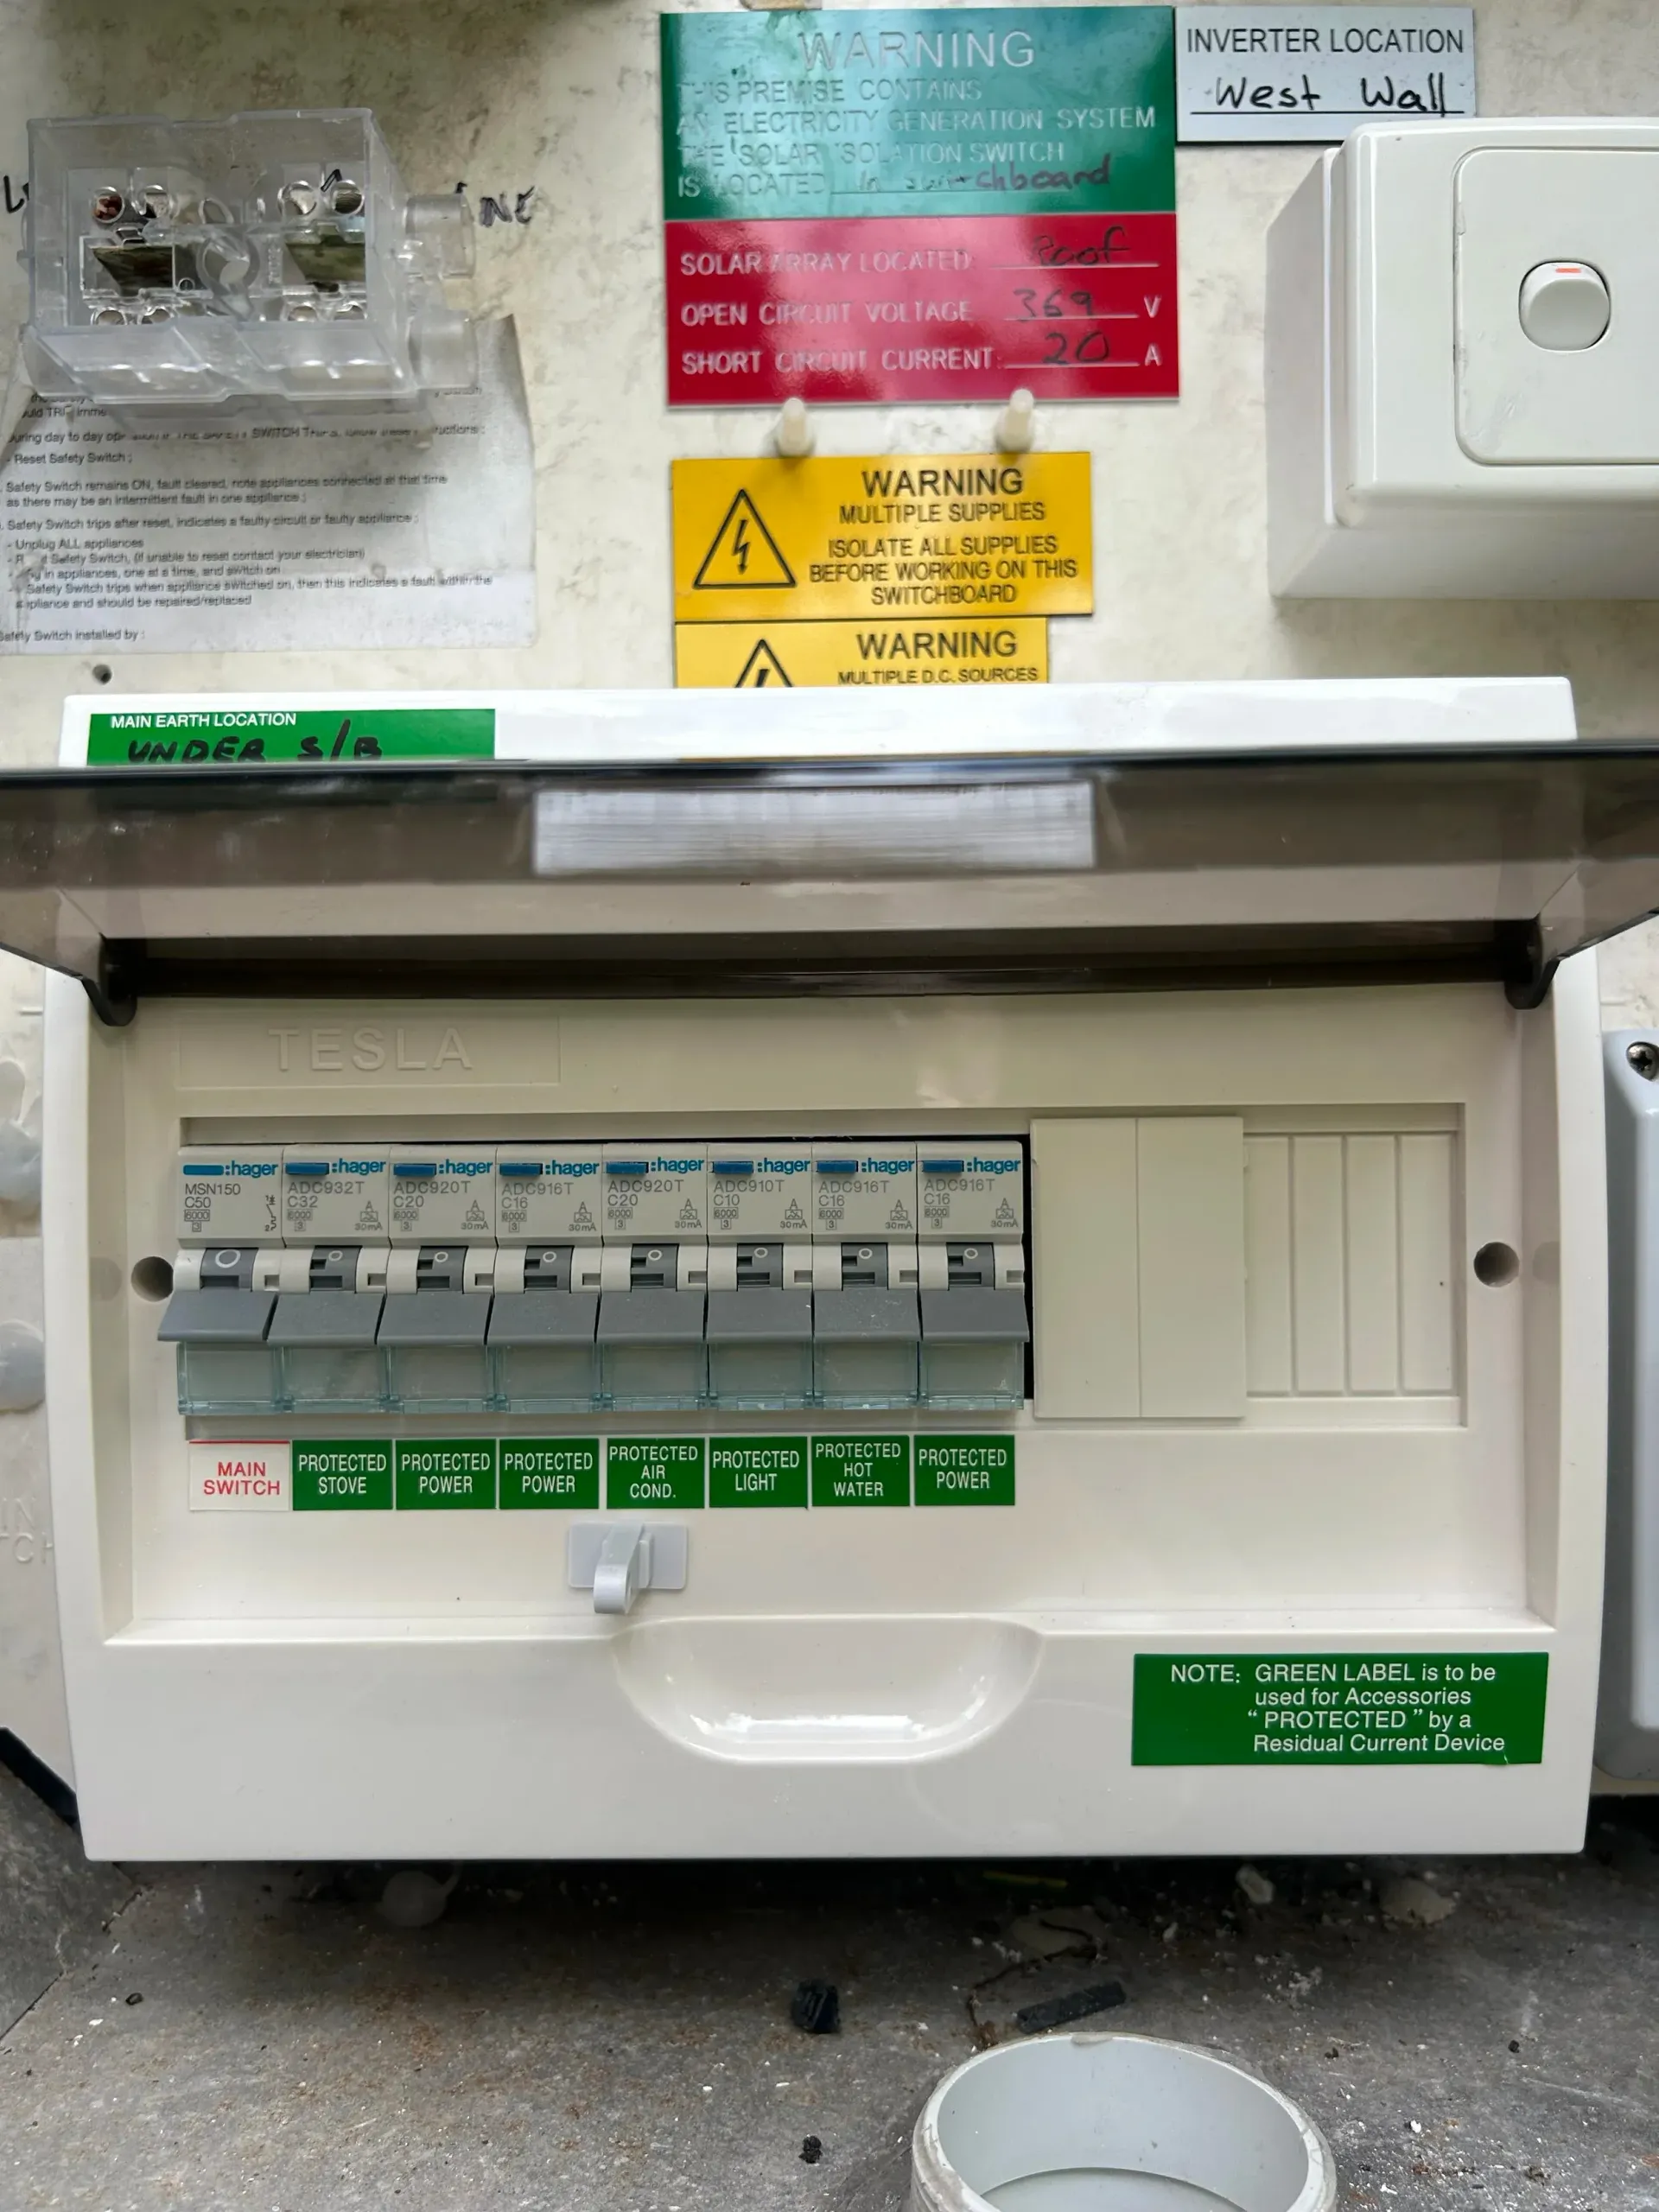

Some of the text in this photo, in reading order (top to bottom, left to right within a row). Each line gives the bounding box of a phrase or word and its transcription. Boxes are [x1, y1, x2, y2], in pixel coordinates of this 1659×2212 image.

[798, 29, 1035, 71] WARNING
[1187, 29, 1464, 54] INVERTER LOCATION
[737, 79, 845, 105] PREMISE
[859, 79, 982, 102] CONTAINS
[1216, 71, 1446, 118] West Wall
[677, 105, 1155, 134] AN ELECTRICITY GENERATION SYSTEM
[678, 141, 1065, 167] THE SOLAR ISOLATION SWITCH
[678, 172, 826, 198] IS LOCATED
[1031, 226, 1131, 267] Roof
[680, 251, 762, 276] SOLAR
[771, 251, 852, 273] ARRAY
[680, 301, 973, 327] OPEN CIRCUIT VOLTAGE
[1012, 288, 1094, 323] 369
[1142, 296, 1161, 319] V
[1042, 329, 1110, 365] 20
[1143, 343, 1162, 367] A
[681, 349, 763, 375] SHORT
[774, 349, 868, 372] CIRCUIT
[44, 432, 102, 444] day to day
[15, 452, 125, 466] Reset Safety Switch
[6, 481, 41, 494] Safety
[45, 480, 82, 493] Switch
[86, 481, 129, 491] remains
[861, 467, 1023, 498] WARNING
[839, 502, 1046, 524] MULTIPLE SUPPLIES
[8, 518, 140, 531] Safety Switch trips after
[16, 538, 144, 551] Unplug ALL appliances
[828, 535, 1058, 558] ISOLATE ALL SUPPLIES
[810, 559, 1078, 582] BEFORE WORKING ON THIS
[871, 584, 1017, 606] SWITCHBOARD
[34, 630, 73, 641] Switch
[75, 629, 121, 640] installed
[124, 630, 138, 641] by
[856, 630, 1018, 661] WARNING
[838, 666, 1038, 686] MULTIPLE D.C. SOURCES
[111, 713, 297, 729] MAIN EARTH LOCATION
[127, 718, 383, 764] UNDER S/B
[268, 1027, 474, 1072] TESLA
[184, 1182, 241, 1196] MSN150
[287, 1181, 365, 1195] ADC932T
[393, 1180, 471, 1194] ADC920T
[501, 1182, 574, 1195] ADC916T
[607, 1179, 684, 1192] ADC920T
[713, 1179, 785, 1192] ADC910T
[818, 1179, 890, 1193] ADC916T
[924, 1178, 995, 1192] ADC916T
[184, 1196, 212, 1210] C50
[287, 1195, 318, 1208] C32
[393, 1195, 424, 1208] C20
[501, 1197, 528, 1209] C16
[607, 1193, 639, 1206] C20
[713, 1193, 741, 1206] C10
[818, 1194, 845, 1207] C16
[924, 1192, 950, 1205] C16
[186, 1211, 209, 1220] 6000
[288, 1211, 311, 1220] 6000
[394, 1211, 417, 1220] 6000
[502, 1211, 526, 1221] 6000
[607, 1209, 632, 1218] 6000
[714, 1209, 738, 1218] 6000
[819, 1210, 842, 1219] 6000
[924, 1207, 949, 1217] 6000
[608, 1446, 698, 1462] PROTECTED
[712, 1450, 800, 1469] PROTECTED
[816, 1443, 901, 1459] PROTECTED
[918, 1448, 1007, 1467] PROTECTED
[218, 1461, 267, 1478] MAIN
[298, 1453, 387, 1472] PROTECTED
[401, 1452, 491, 1471] PROTECTED
[504, 1452, 594, 1471] PROTECTED
[843, 1462, 874, 1478] HOT
[641, 1465, 666, 1480] AIR
[936, 1471, 990, 1491] POWER
[203, 1479, 281, 1496] SWITCH
[318, 1476, 367, 1495] STOVE
[418, 1475, 474, 1494] POWER
[522, 1474, 576, 1494] POWER
[734, 1472, 778, 1492] LIGHT
[834, 1481, 884, 1497] WATER
[629, 1483, 677, 1499] COND.
[1171, 1663, 1497, 1685] NOTE: GREEN LABEL is to be
[1255, 1687, 1471, 1707] used for Accessories
[1264, 1710, 1471, 1733] PROTECTED by a
[1254, 1732, 1506, 1753] Residual Current Device
